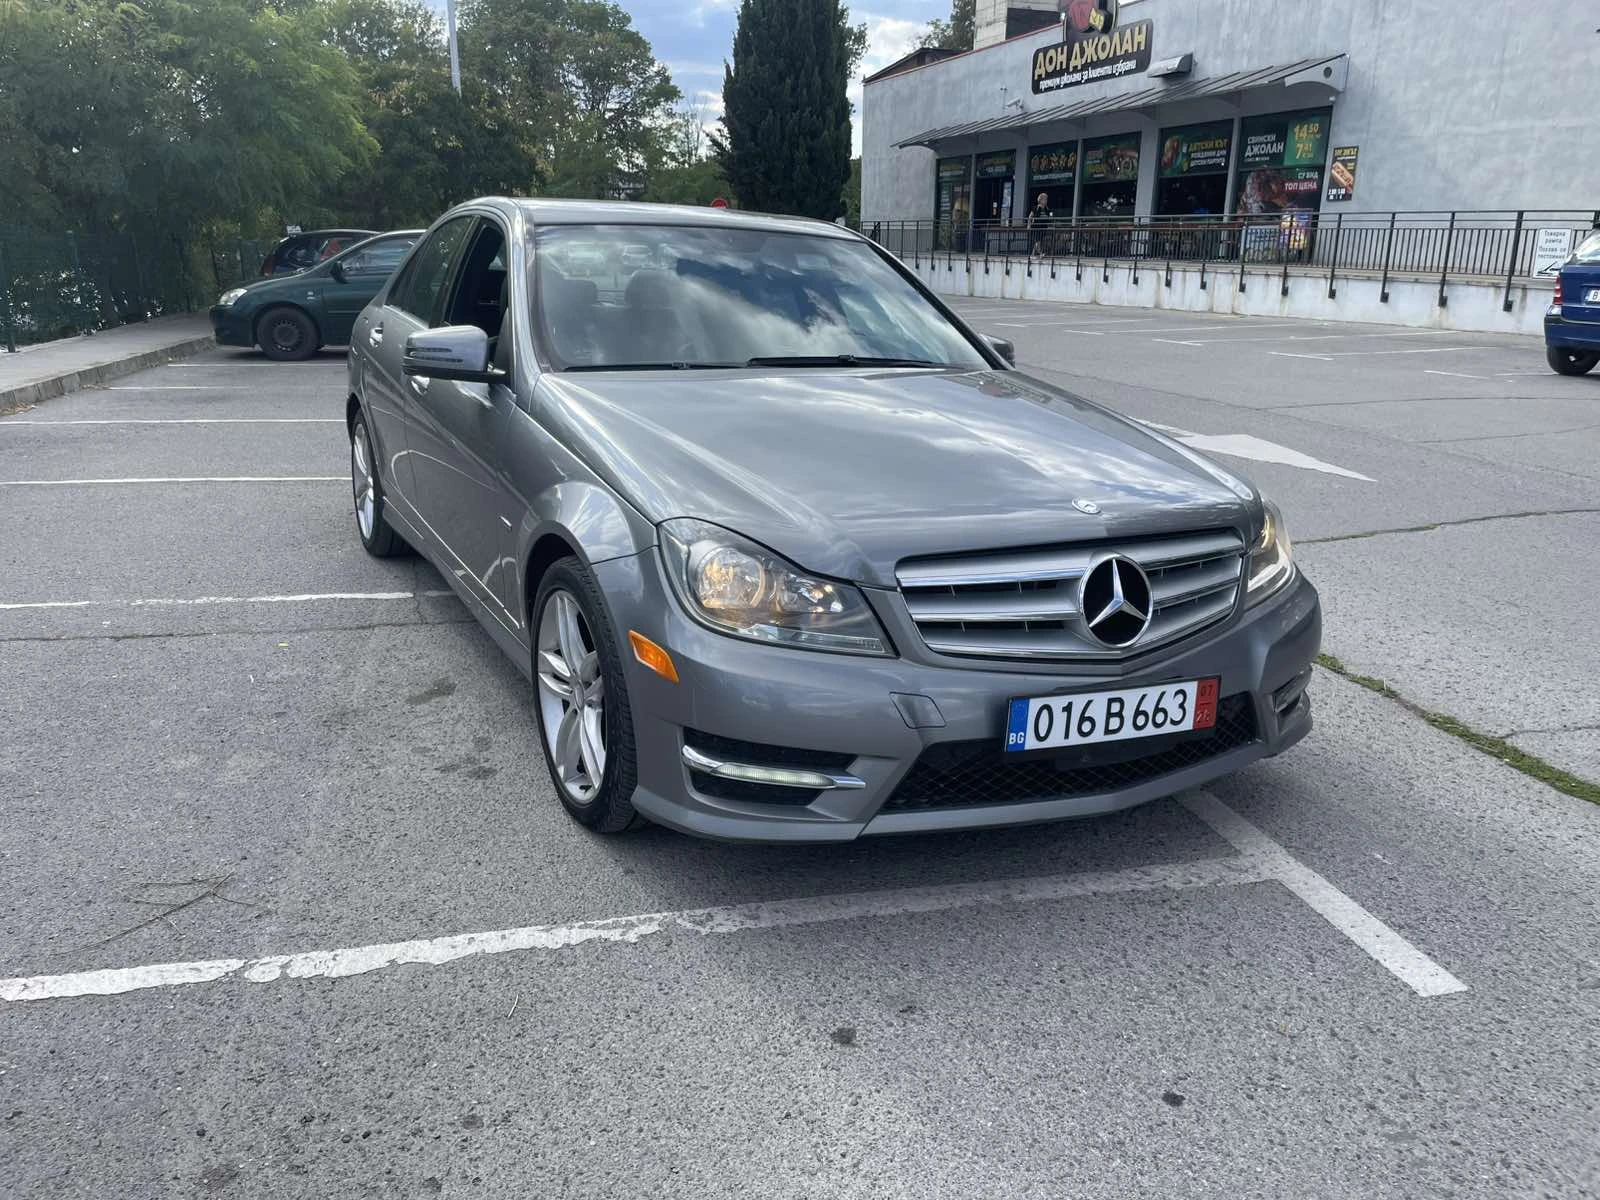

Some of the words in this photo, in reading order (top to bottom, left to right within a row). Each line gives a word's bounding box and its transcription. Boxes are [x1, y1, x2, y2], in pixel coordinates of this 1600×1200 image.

[1034, 45, 1068, 80] ДОН
[1069, 23, 1147, 71] ДЖОЛАН
[1247, 133, 1277, 144] СВИНСКИ
[1245, 142, 1284, 158] ДЖОЛАН
[1284, 182, 1298, 191] ТОП
[1298, 181, 1318, 190] ЦЕНА
[1008, 731, 1025, 745] BG
